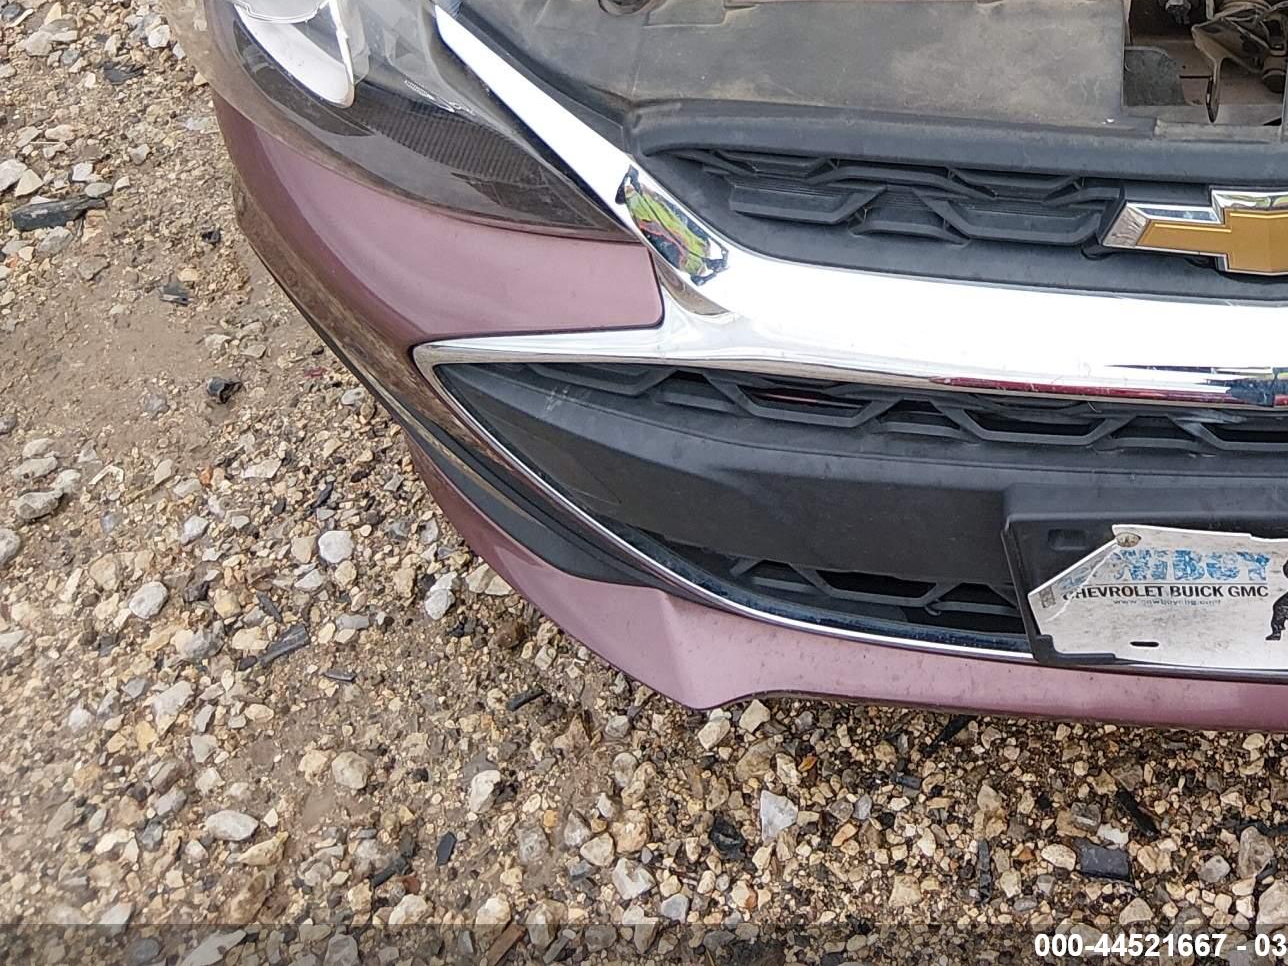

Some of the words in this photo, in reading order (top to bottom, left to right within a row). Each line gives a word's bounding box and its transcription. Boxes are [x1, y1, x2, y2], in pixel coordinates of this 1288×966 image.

[1062, 585, 1165, 600] CHEVROLET
[1169, 585, 1224, 598] BUICK
[1227, 585, 1269, 598] GMC
